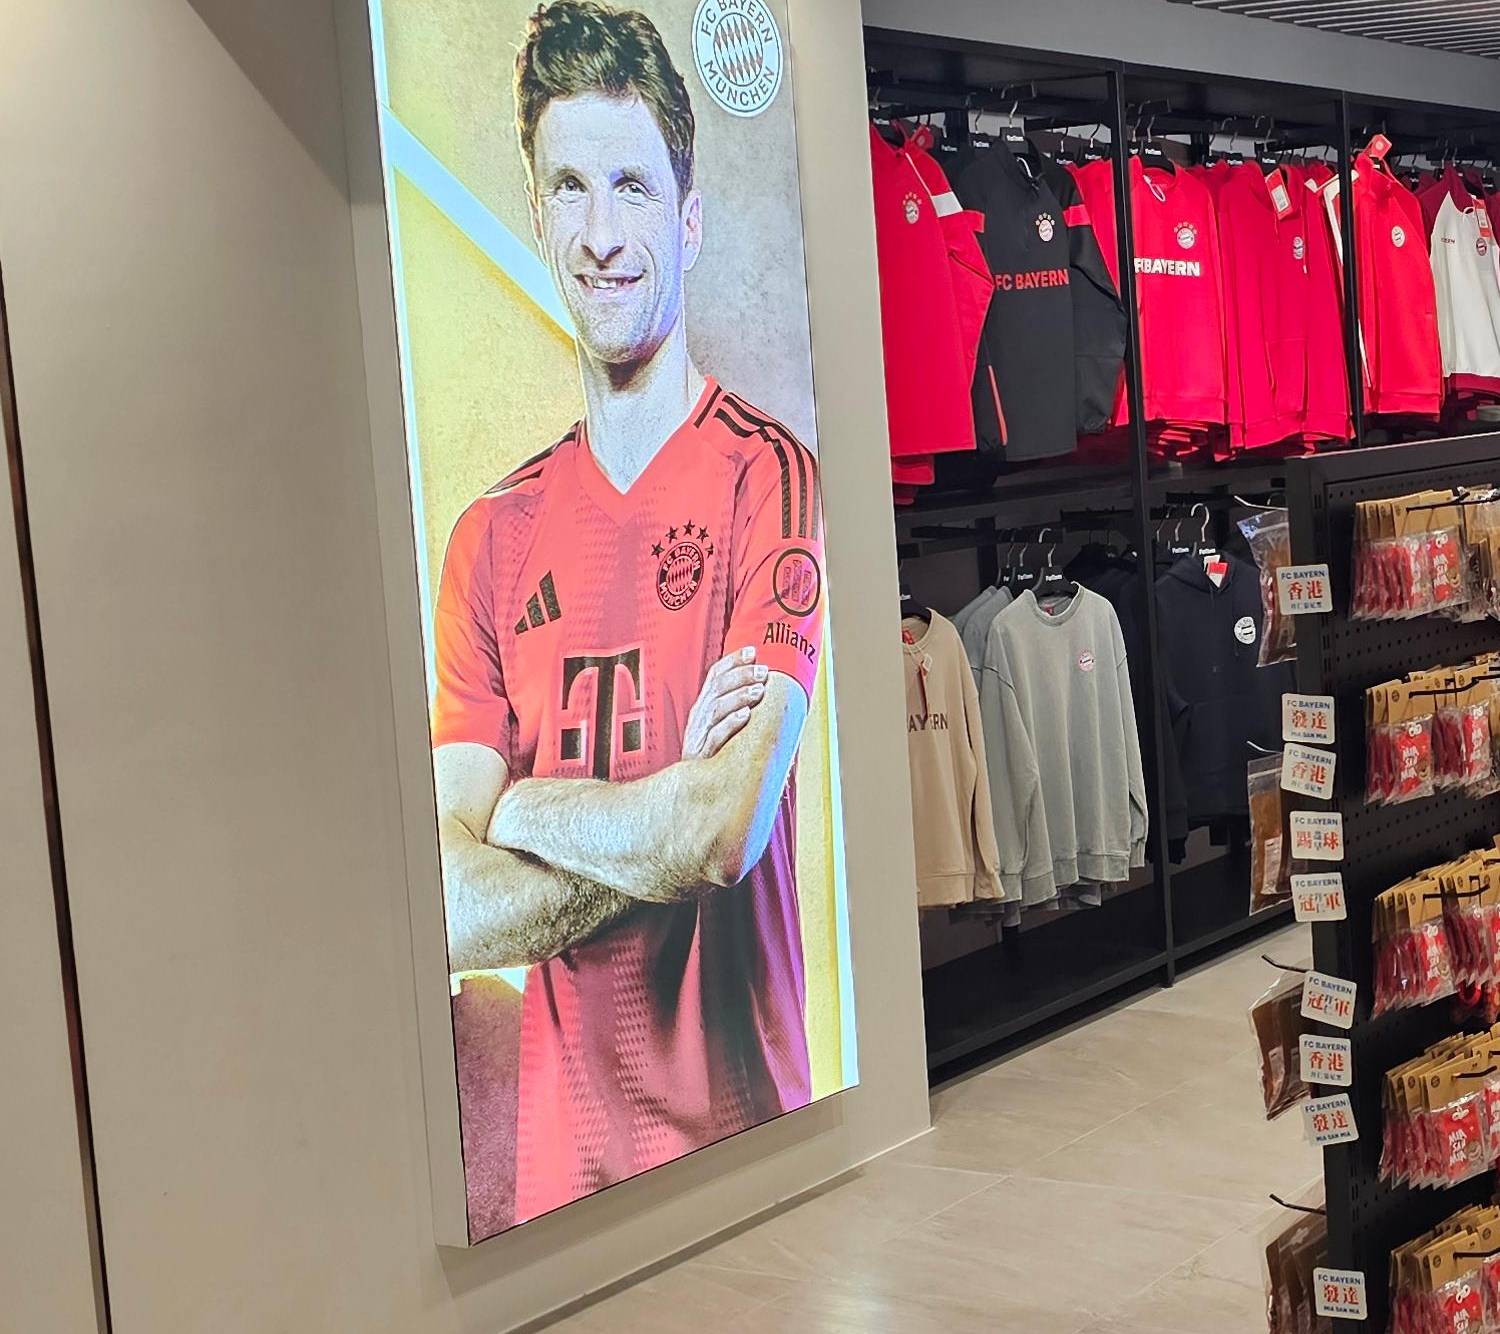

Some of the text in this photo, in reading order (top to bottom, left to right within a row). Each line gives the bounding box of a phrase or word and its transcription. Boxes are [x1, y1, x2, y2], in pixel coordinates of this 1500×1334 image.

[700, 7, 717, 38] FC
[703, 59, 776, 107] MÜNCHEN
[1144, 258, 1200, 276] BAYERN
[995, 269, 1070, 291] FC BAYERN
[1294, 570, 1326, 579] BAYERN
[762, 621, 817, 665] Allianz
[1298, 700, 1330, 710] BAYERN
[1288, 750, 1332, 765] FC BAYERN
[1307, 818, 1338, 826] BAYERN
[1307, 879, 1339, 887] BAYERN
[1309, 977, 1352, 995] FC BAYERN
[1304, 1040, 1347, 1052] FC BAYERN
[1305, 1100, 1347, 1113] FC BAYERN
[1318, 1274, 1361, 1285] FC BAYERN
